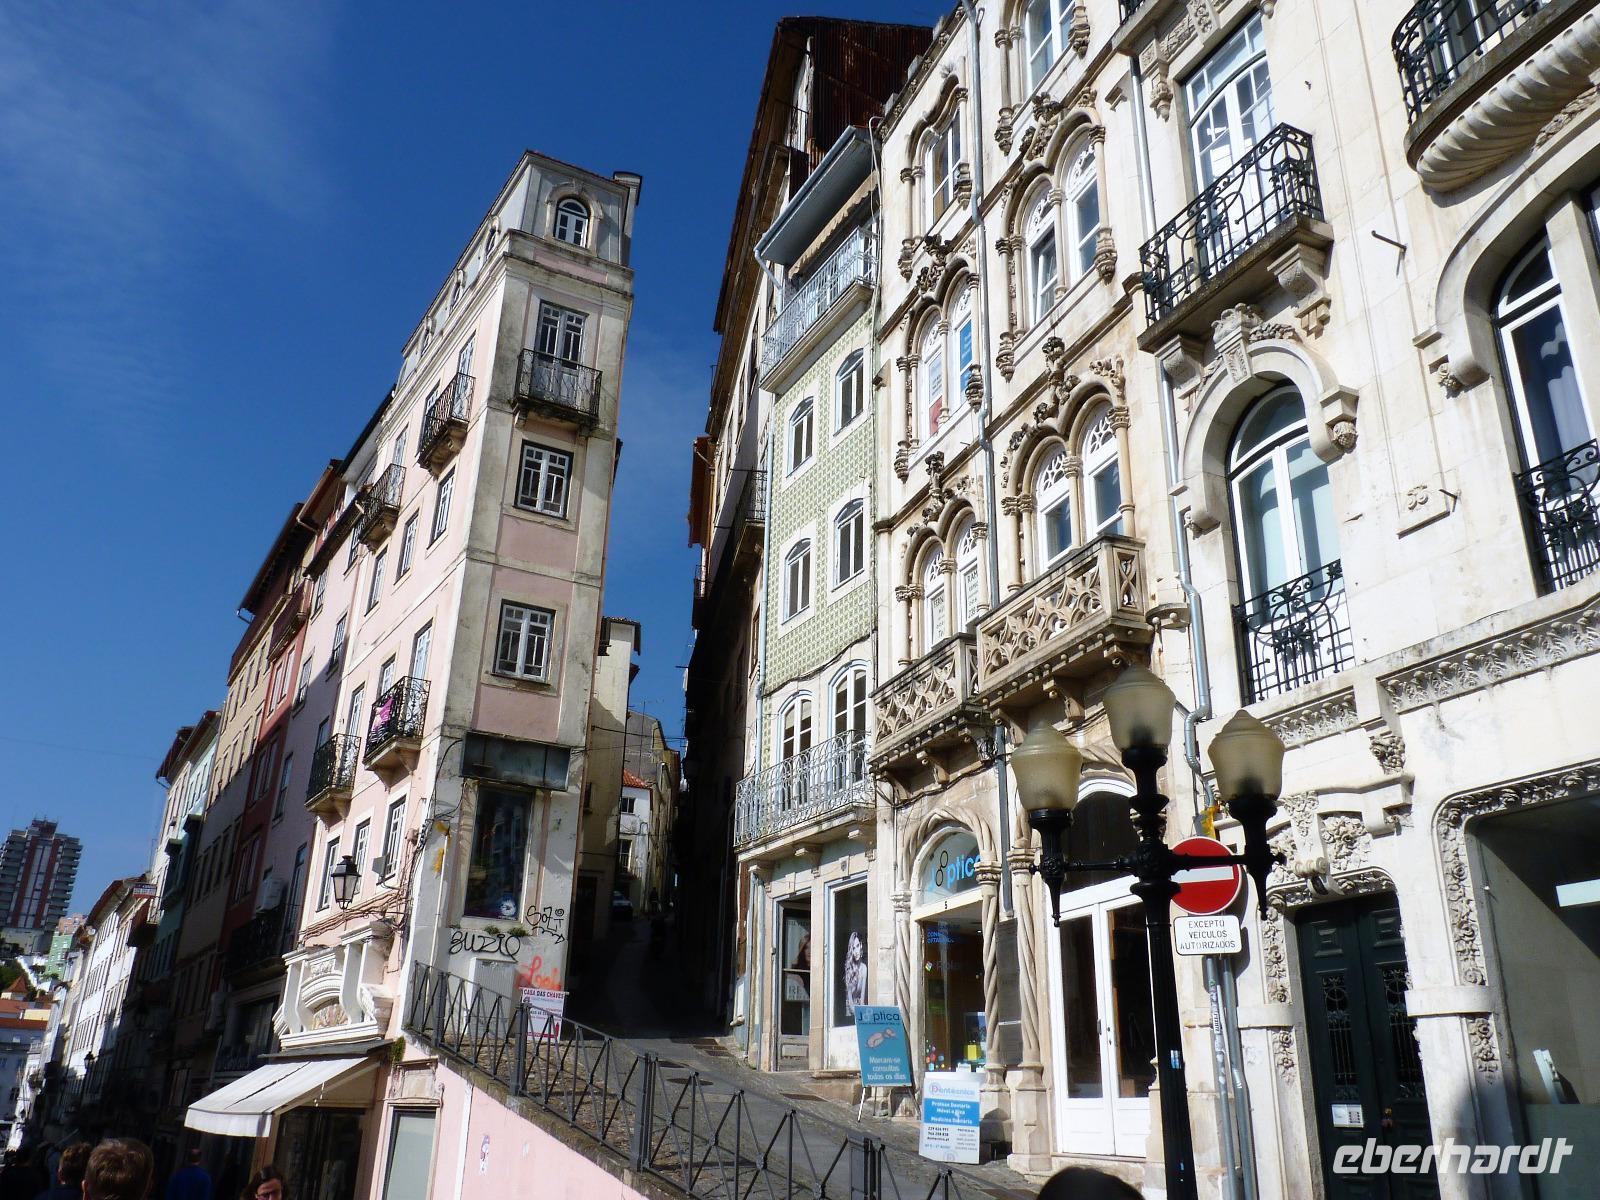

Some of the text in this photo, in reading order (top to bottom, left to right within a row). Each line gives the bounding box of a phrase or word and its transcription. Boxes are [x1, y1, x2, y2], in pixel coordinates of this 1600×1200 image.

[1188, 919, 1225, 928] EXCEPTO
[1180, 940, 1236, 950] AUTORIZADOS
[872, 1064, 900, 1072] consultas
